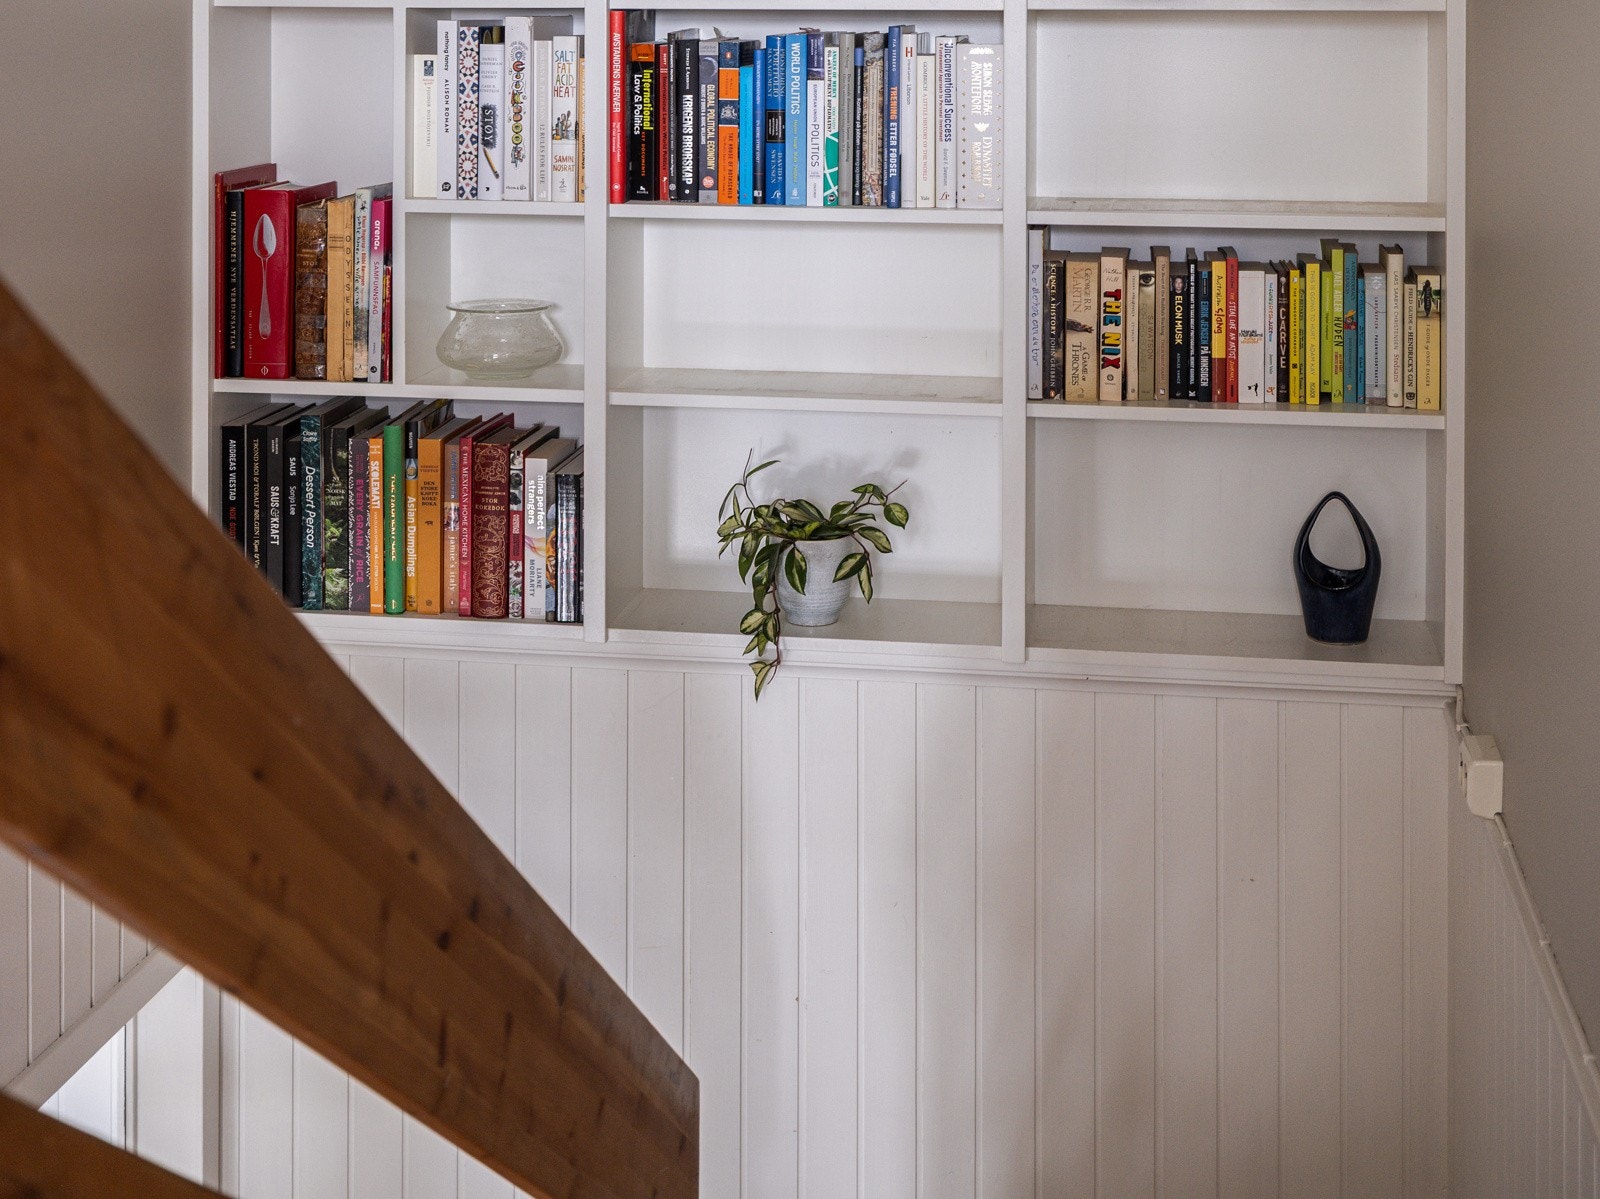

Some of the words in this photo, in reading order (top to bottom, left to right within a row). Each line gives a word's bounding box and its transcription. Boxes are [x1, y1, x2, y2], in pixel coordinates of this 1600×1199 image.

[554, 50, 575, 62] SALT
[557, 62, 572, 74] FAT
[612, 32, 621, 78] AVSTANDENS
[791, 42, 799, 72] WORLD
[555, 74, 574, 86] ACID
[634, 74, 642, 92] Law
[944, 43, 954, 106] Unconventional
[554, 86, 575, 98] HEAT
[612, 80, 621, 112] NÆRVÆR
[634, 94, 642, 102] &
[643, 69, 653, 130] International
[706, 84, 715, 106] GLOBAL
[791, 75, 799, 114] POLITICS
[485, 109, 493, 142] STØY
[634, 103, 642, 135] Politics
[682, 94, 693, 133] KRIGENS
[706, 108, 715, 138] POLITICAL
[944, 109, 953, 142] Success
[682, 135, 692, 184] BRORSKAP
[706, 141, 715, 170] ECONOMY
[810, 123, 819, 167] POLITICS
[553, 164, 575, 172] NOSRAT
[889, 149, 898, 178] FØDSEL
[372, 261, 380, 314] SAMFUNNSFAG
[1334, 271, 1342, 287] YAEL
[1102, 289, 1121, 326] THE
[1175, 295, 1183, 318] ELON
[1201, 301, 1209, 317] EIRIK
[1334, 290, 1342, 312] ADLER
[1175, 320, 1183, 345] MUSK
[1201, 319, 1209, 344] JENSEN
[1334, 316, 1343, 346] HUDEN
[1072, 343, 1082, 386] THRONES
[1082, 353, 1090, 375] GAME
[1102, 332, 1121, 370] NIX
[1201, 346, 1211, 355] PÅ
[1201, 356, 1209, 386] INNSIDEN
[306, 466, 316, 507] Dessert
[355, 479, 363, 511] EVERY
[537, 476, 545, 495] nine
[407, 496, 416, 522] Asian
[527, 480, 535, 525] strangers
[536, 497, 545, 530] perfect
[306, 510, 316, 548] Person
[355, 515, 363, 546] GRAIN
[406, 525, 416, 577] Dumplings
[448, 536, 456, 567] jamie's
[448, 571, 456, 592] italy
